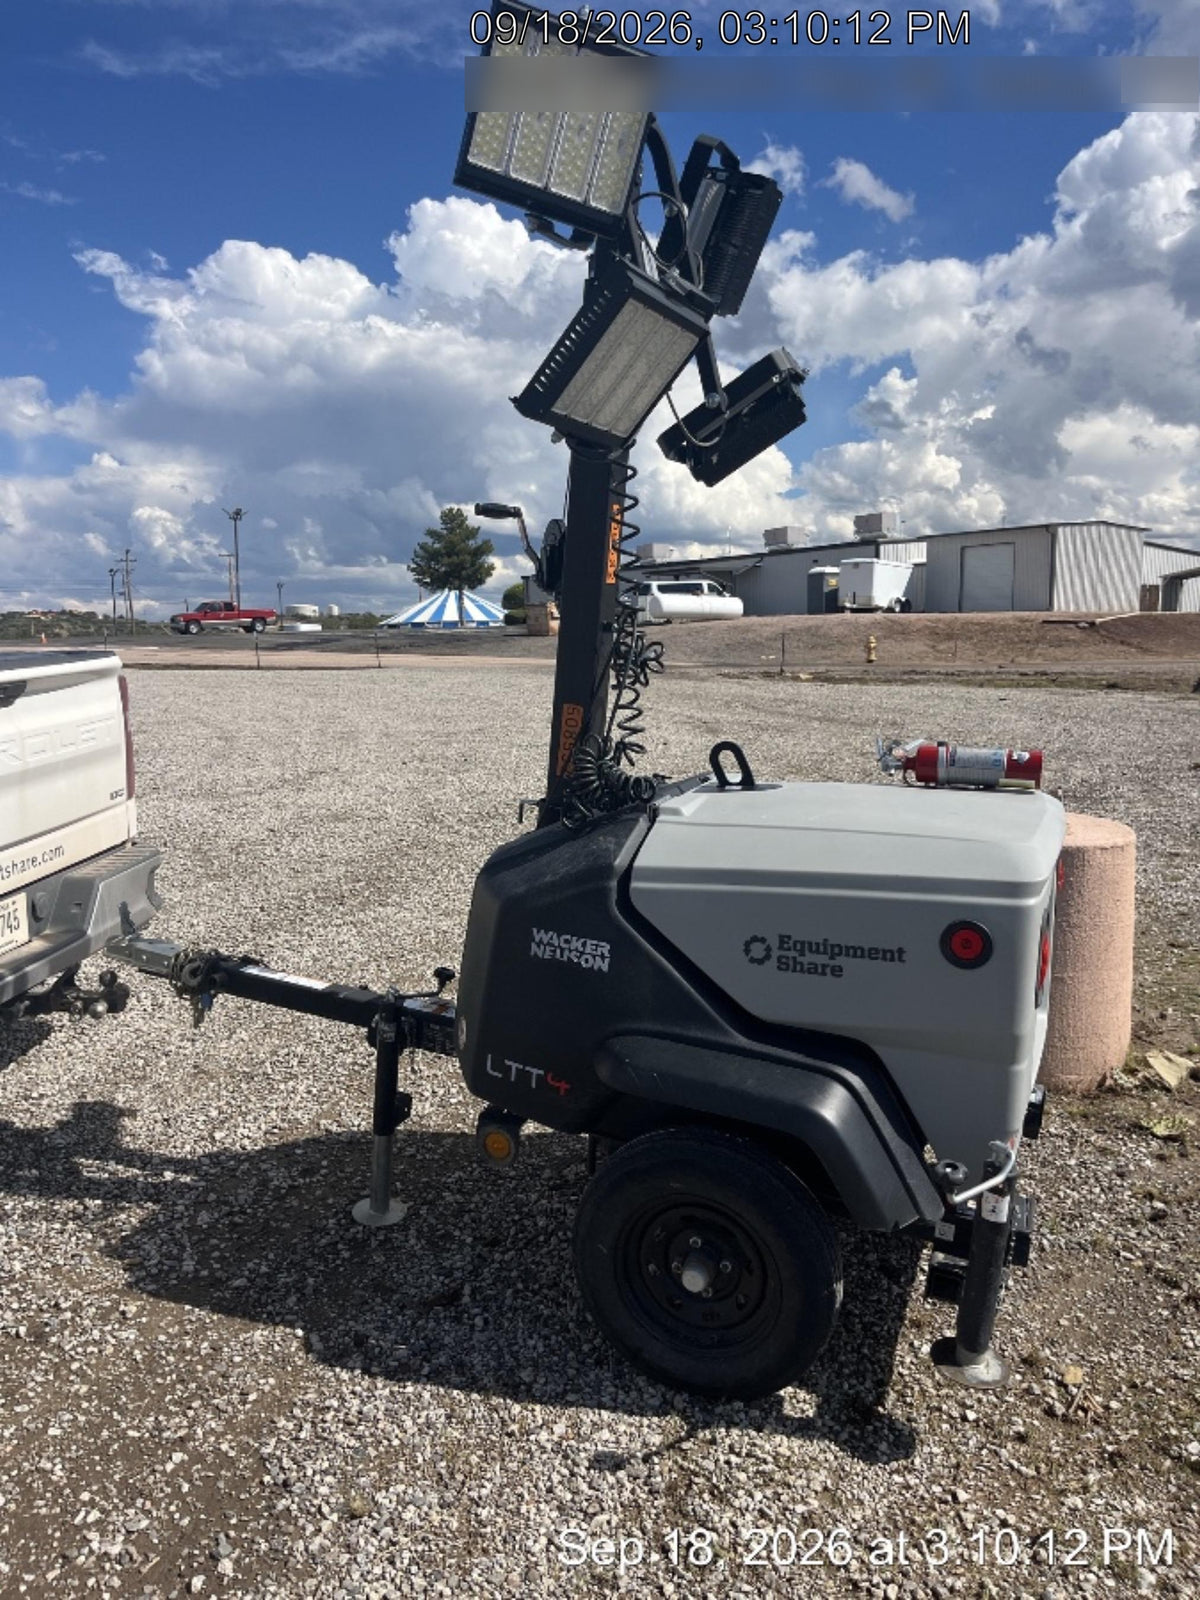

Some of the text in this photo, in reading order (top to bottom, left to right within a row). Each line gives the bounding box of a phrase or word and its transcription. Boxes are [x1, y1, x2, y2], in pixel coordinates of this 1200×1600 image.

[531, 927, 611, 957] WACKER
[777, 934, 906, 964] Equipment
[530, 943, 611, 972] NEUSON
[776, 955, 844, 978] Share
[486, 1054, 571, 1096] LTT4
